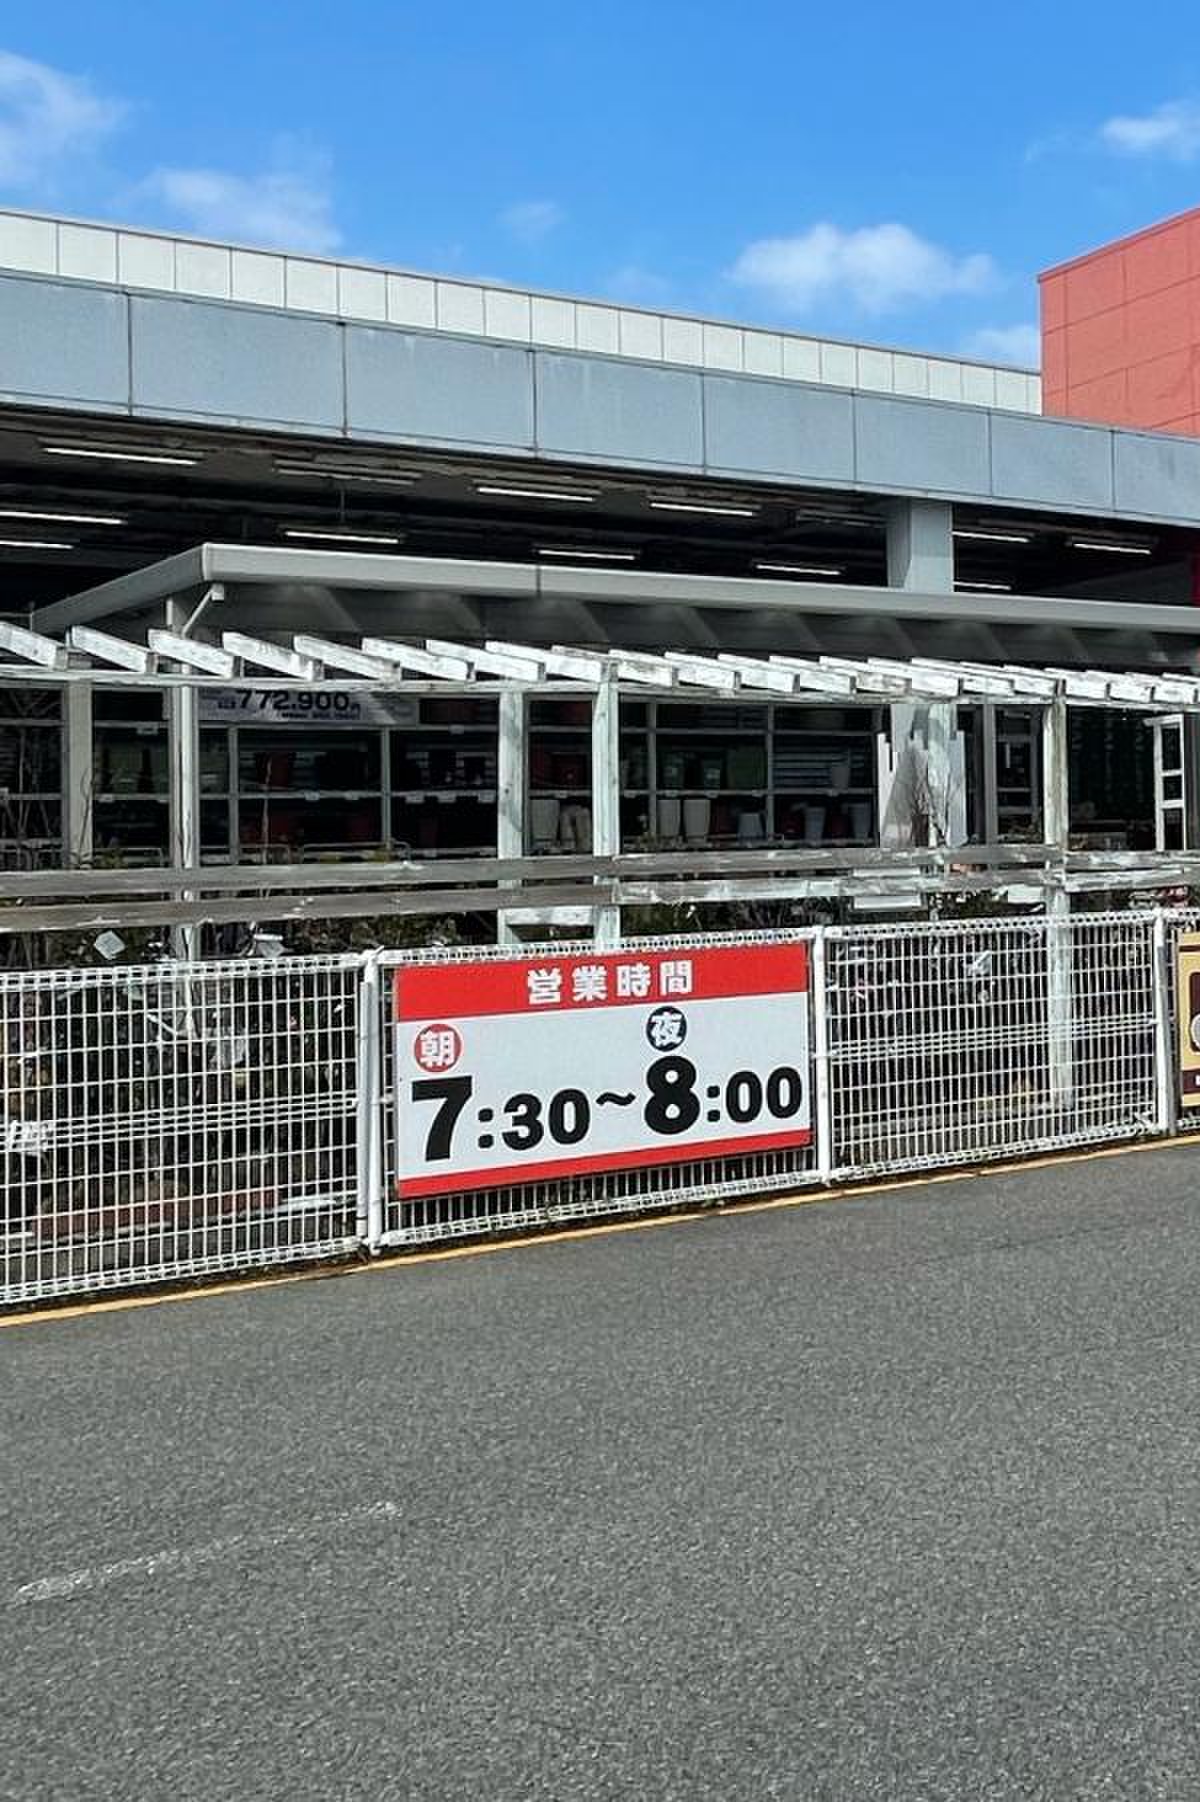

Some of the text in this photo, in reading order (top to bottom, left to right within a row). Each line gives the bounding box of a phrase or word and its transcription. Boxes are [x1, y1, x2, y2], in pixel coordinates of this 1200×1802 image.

[527, 960, 693, 1004] 営業時間
[418, 1027, 459, 1068] 朝
[648, 1009, 685, 1048] 夜
